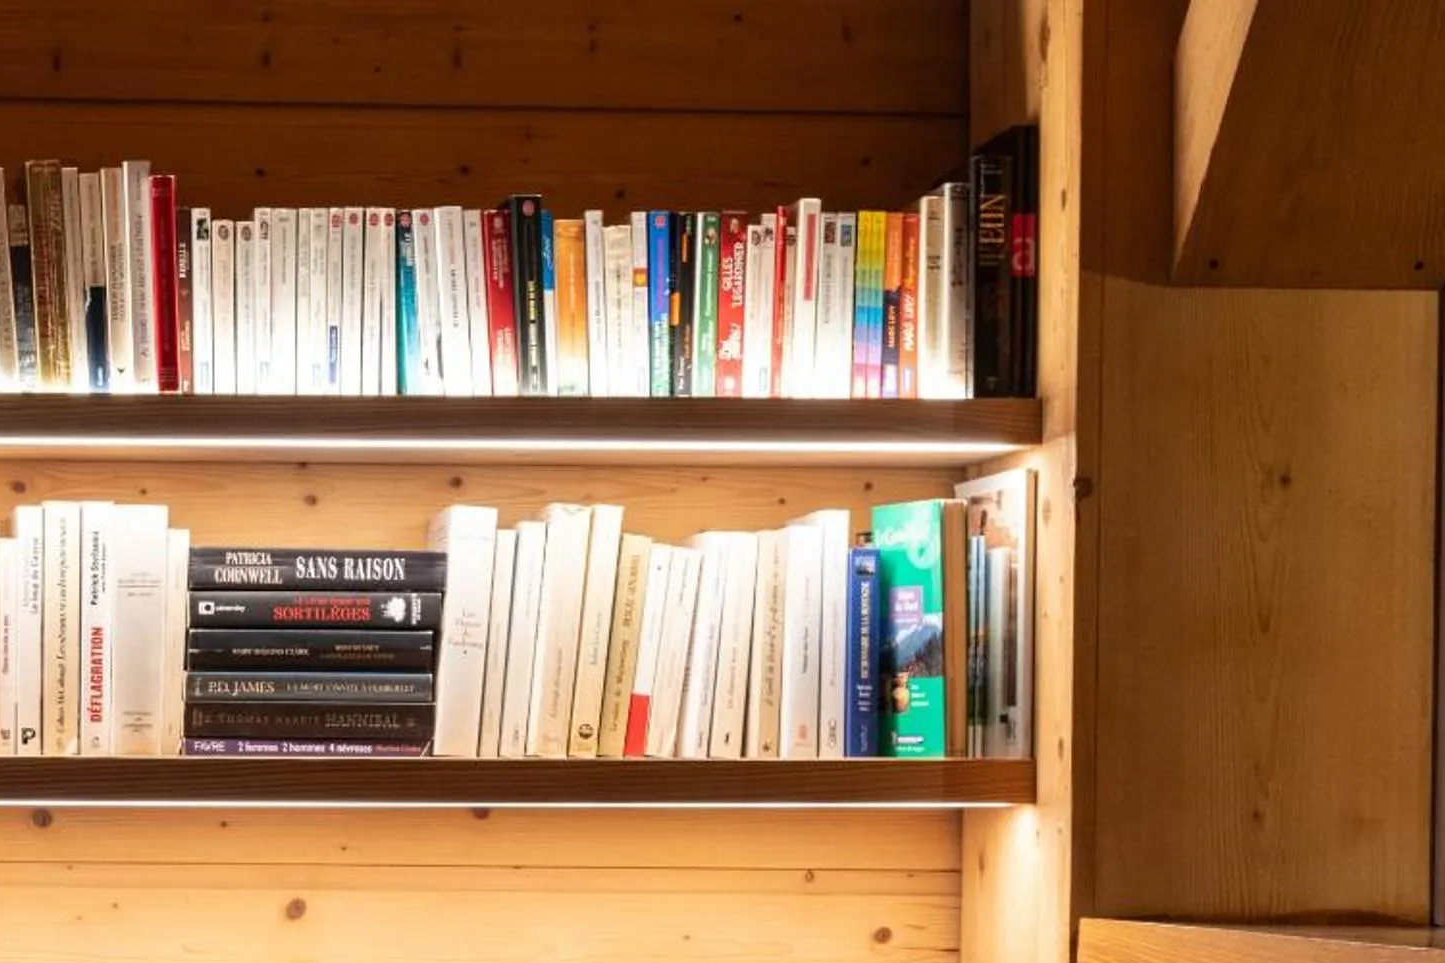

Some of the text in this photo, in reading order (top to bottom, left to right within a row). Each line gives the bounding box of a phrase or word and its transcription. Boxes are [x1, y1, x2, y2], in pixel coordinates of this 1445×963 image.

[214, 567, 283, 585] CORNWELL
[295, 555, 338, 580] SANS
[343, 556, 406, 582] RAISON
[86, 626, 104, 723] DÉFLAGRATION
[232, 680, 276, 697] JAMES
